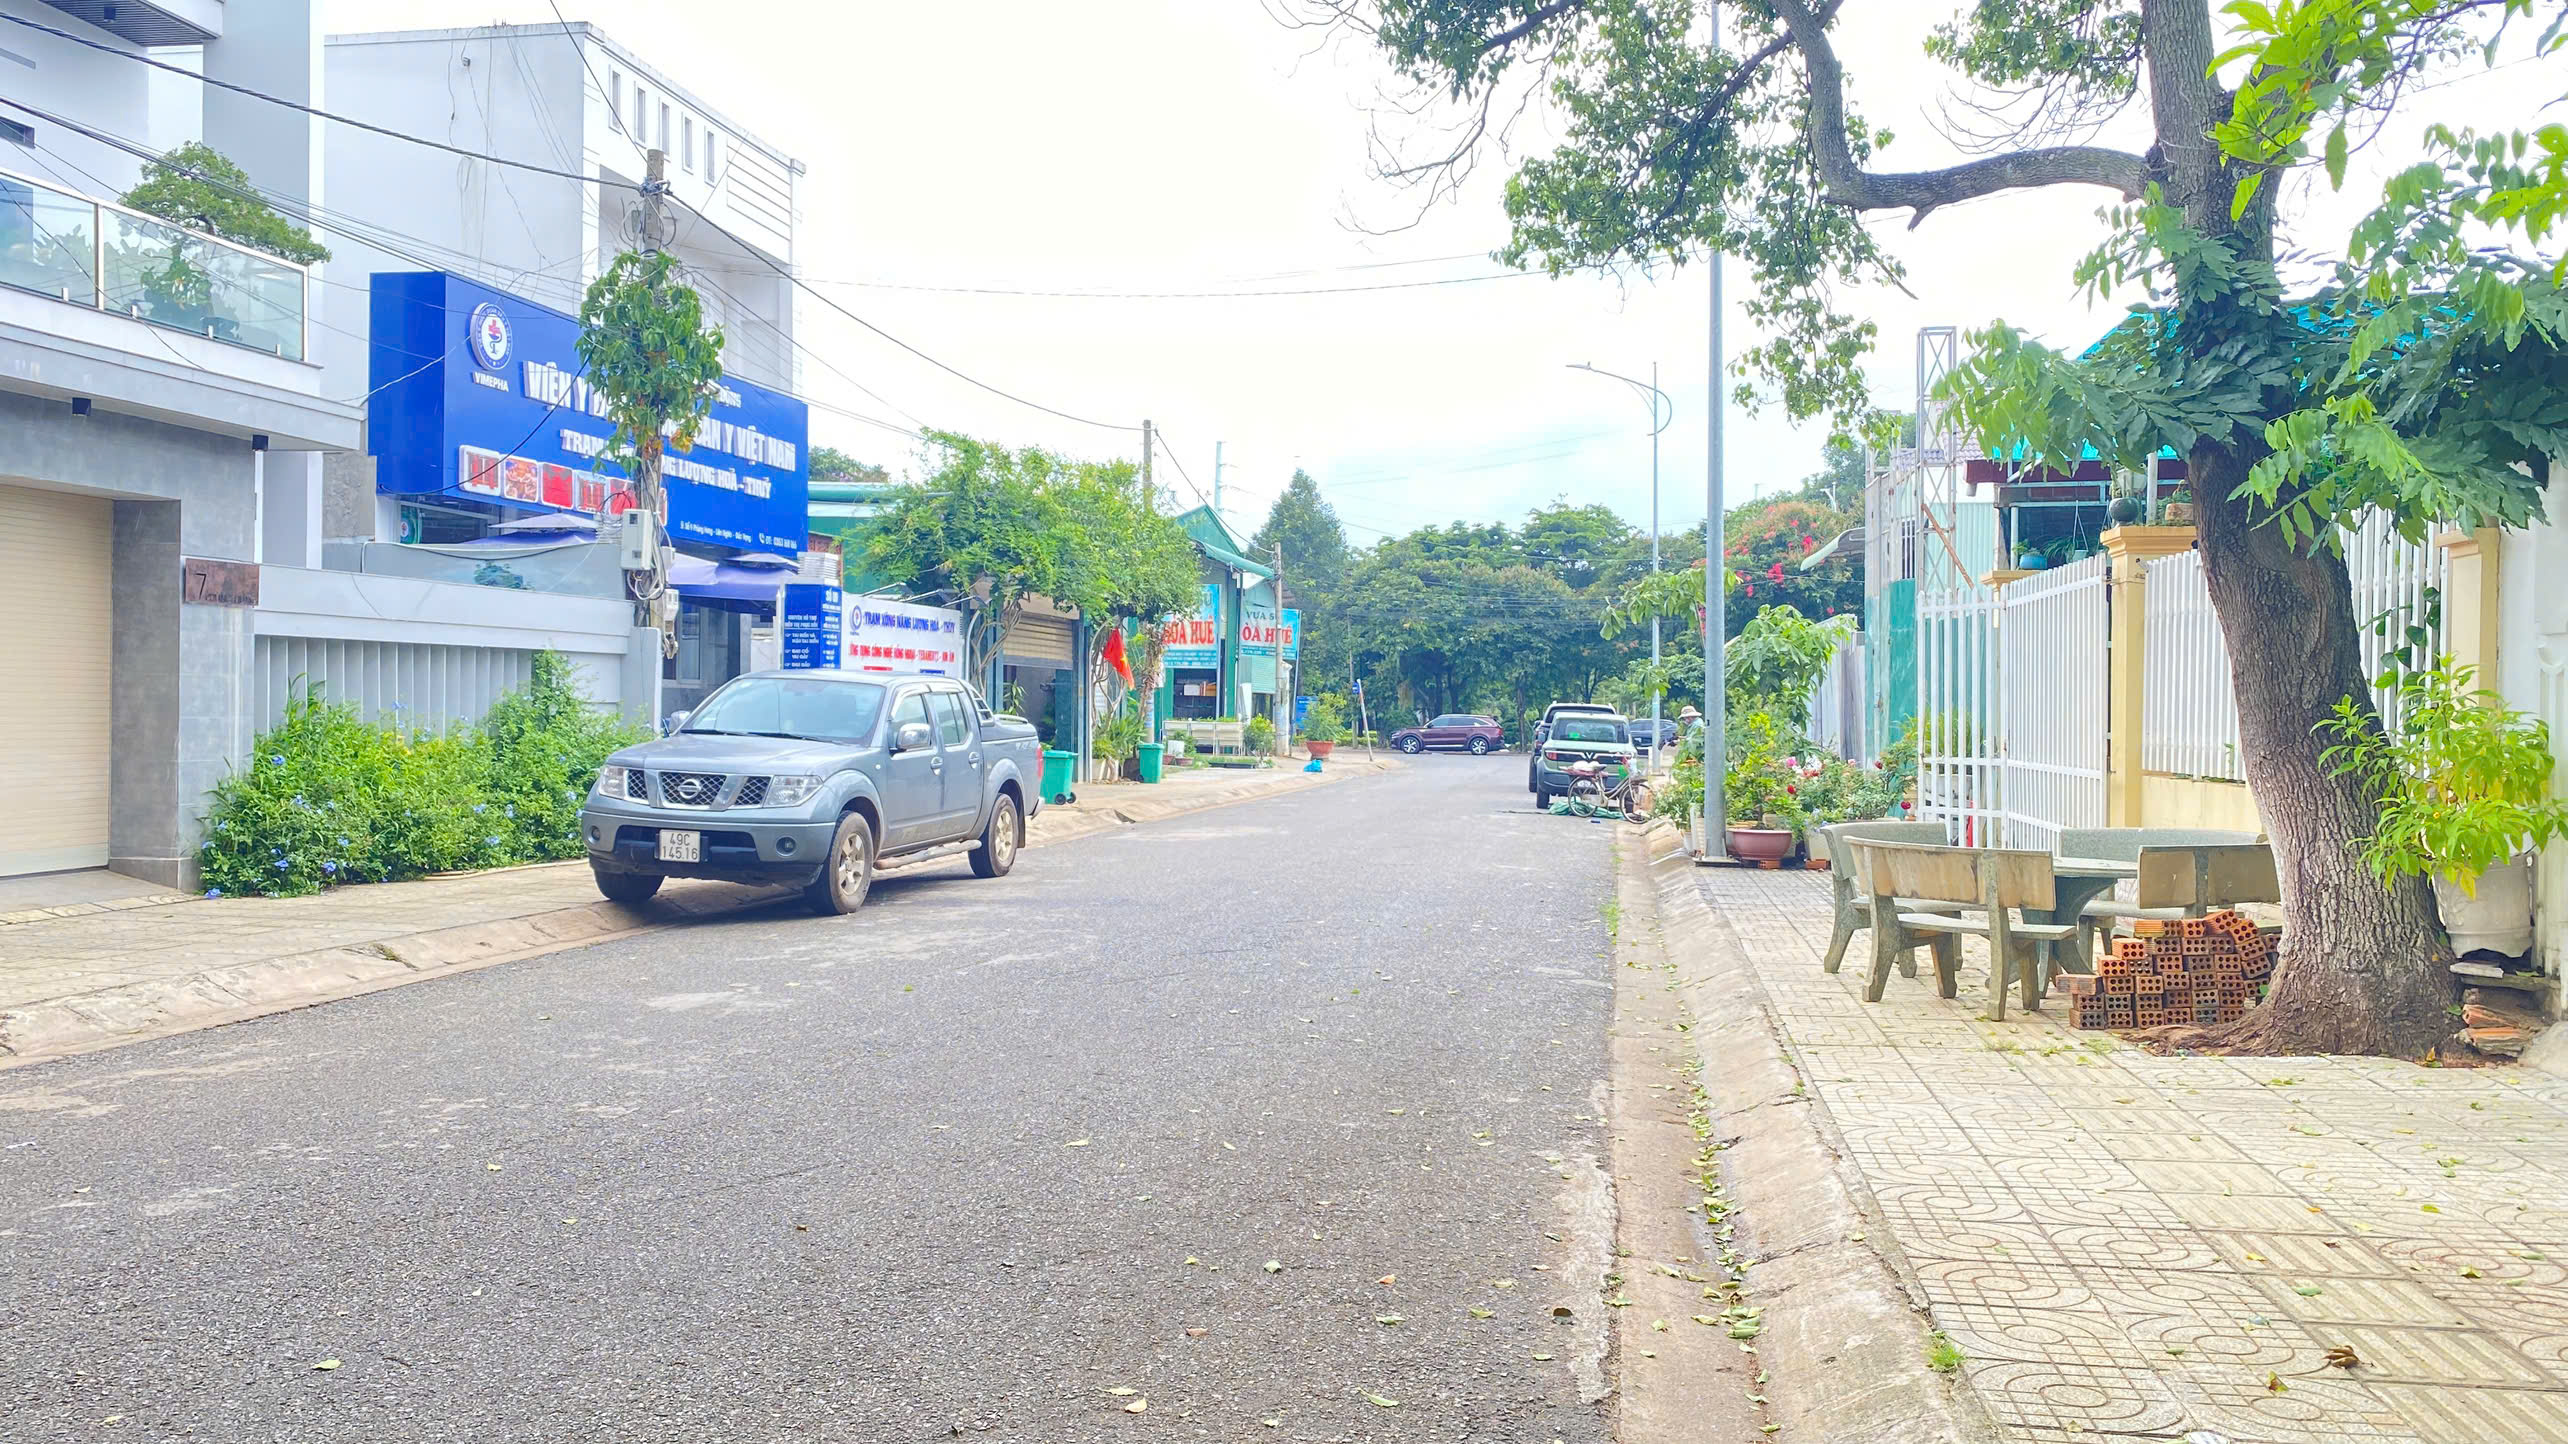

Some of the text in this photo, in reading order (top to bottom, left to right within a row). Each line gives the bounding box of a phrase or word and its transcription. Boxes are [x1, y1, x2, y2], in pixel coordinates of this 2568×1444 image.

[474, 371, 510, 392] VIMEPHA
[522, 360, 572, 412] VIỆN
[573, 376, 589, 412] Y
[721, 421, 735, 454] Y
[734, 424, 766, 466] VIỆT
[764, 435, 796, 473] NAM
[678, 457, 716, 485] LƯỢNG
[194, 573, 207, 600] 7
[669, 833, 690, 847] 49C
[662, 846, 698, 860] 145.16
